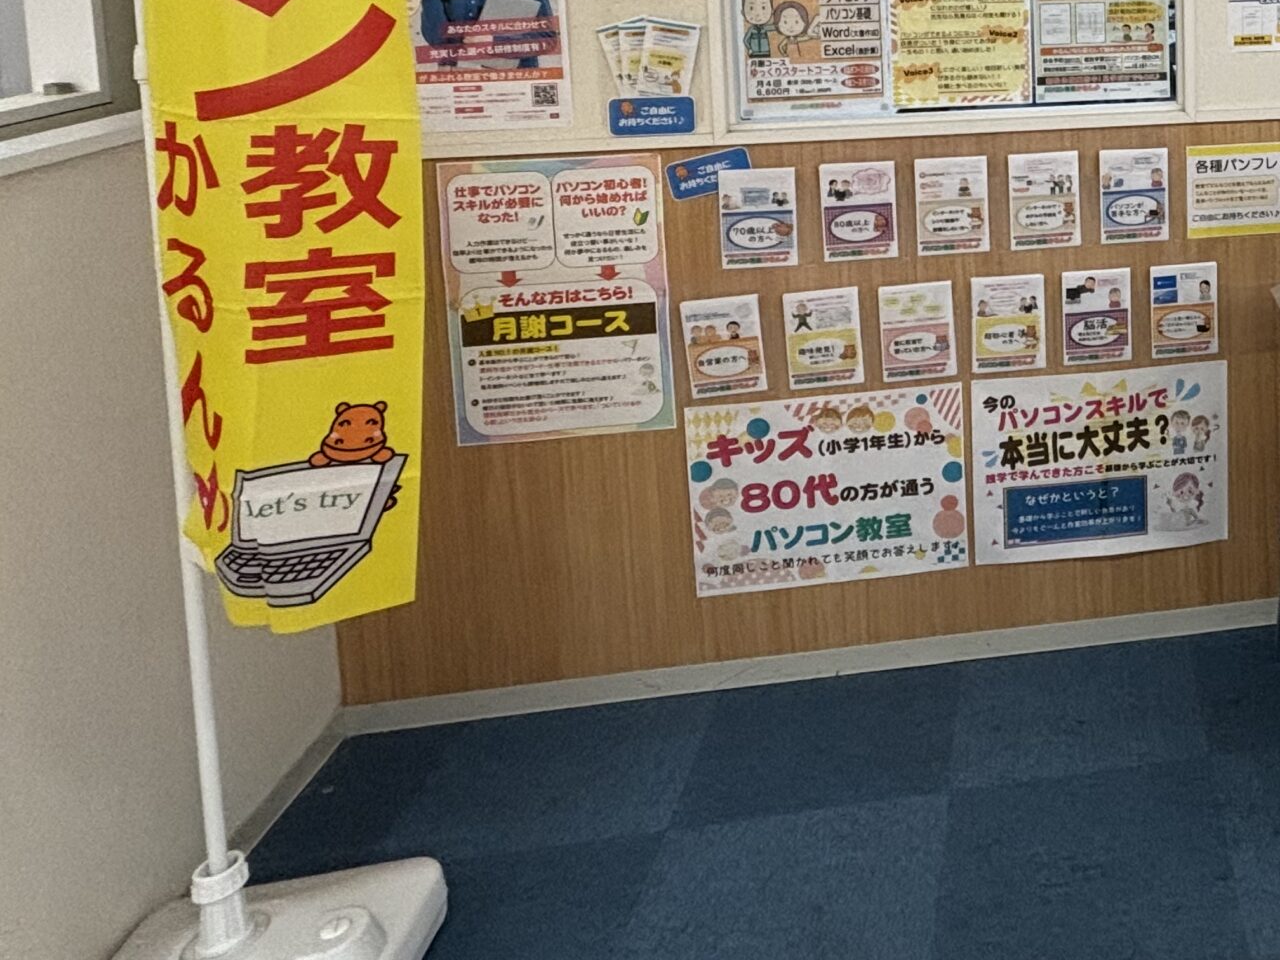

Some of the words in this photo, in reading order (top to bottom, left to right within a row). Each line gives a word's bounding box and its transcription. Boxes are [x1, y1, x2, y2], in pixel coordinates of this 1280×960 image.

[825, 7, 872, 21] パソコン基礎
[988, 29, 1019, 38] Voice2
[903, 67, 934, 77] Voice3
[454, 183, 541, 198] 仕事でパソコン
[555, 177, 648, 193] パソコン初心者!
[453, 196, 545, 212] スキルが必要に
[559, 191, 648, 208] 何から始めれば
[477, 211, 519, 224] なった!
[581, 205, 627, 218] いいの?
[498, 286, 633, 307] そんな方はこちら!
[492, 310, 631, 341] 月謝コース
[1083, 319, 1108, 331] 脳活
[982, 394, 1016, 413] 今の
[998, 387, 1169, 432] パソコンスキルで
[706, 424, 815, 467] キッズ
[818, 429, 946, 457] (小学1年生)から
[998, 414, 1170, 471] 本当に大丈夫?
[319, 487, 362, 516] try
[740, 472, 935, 514] 80代の方が通う
[750, 513, 913, 553] パソコン教室
